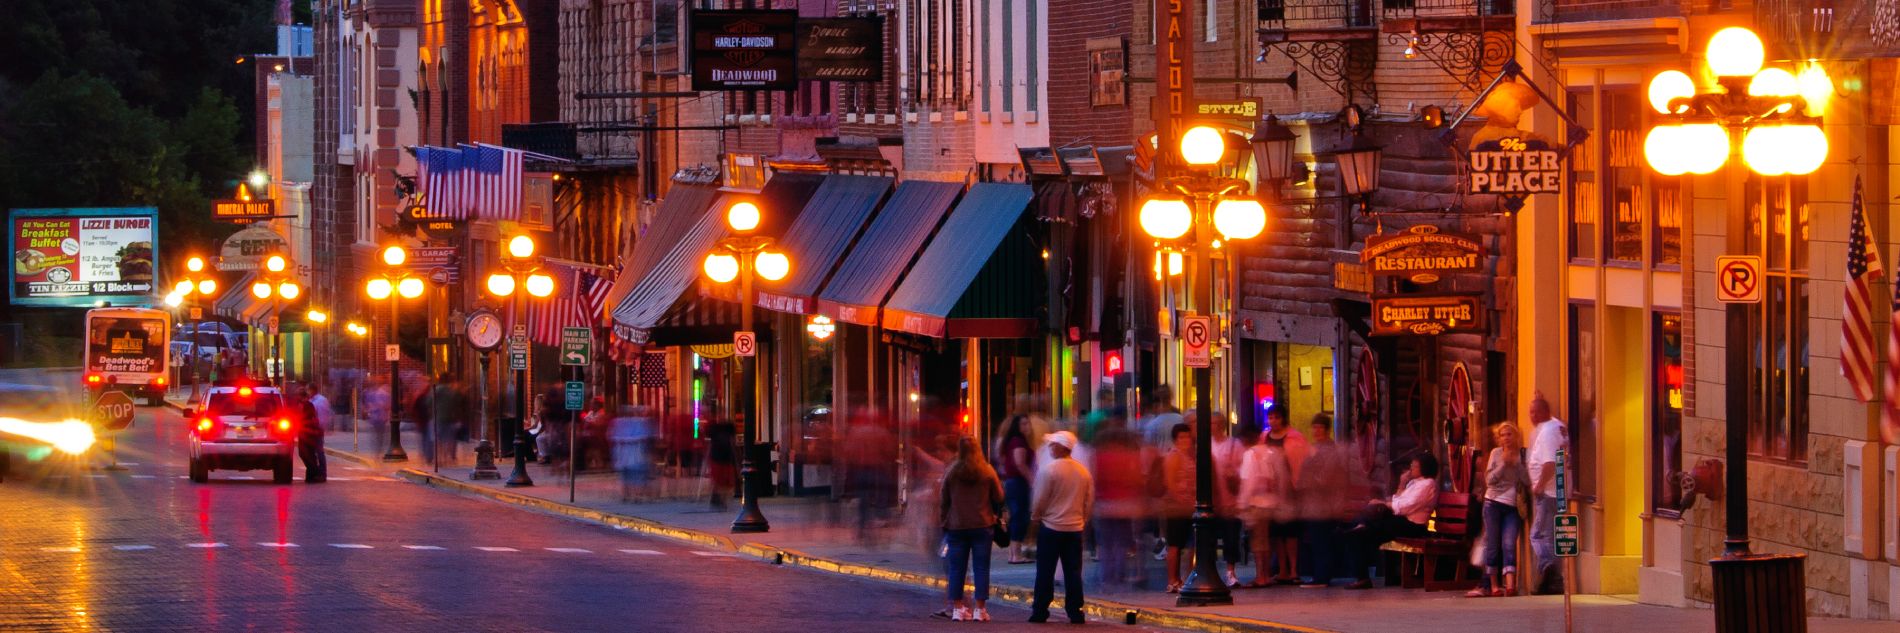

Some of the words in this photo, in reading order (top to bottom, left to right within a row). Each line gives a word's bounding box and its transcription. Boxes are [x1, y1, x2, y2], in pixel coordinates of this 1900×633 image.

[714, 36, 774, 48] HARLEY-DAVIDSON
[712, 69, 777, 81] DEADWOOD
[1168, 0, 1183, 140] SALOON
[1198, 101, 1257, 117] STYLE
[1471, 151, 1559, 172] UTTER
[1471, 171, 1559, 192] PLACE
[217, 203, 245, 215] MINERAL
[246, 202, 269, 215] PALACE
[82, 219, 111, 230] LIZZIE
[113, 218, 150, 230] BURGER
[429, 222, 454, 230] HOTEL
[21, 228, 69, 238] Breakfast
[30, 238, 61, 248] Buffet
[1371, 235, 1421, 256] DEADWOOD
[1423, 235, 1455, 244] SOCIAL
[1457, 239, 1479, 252] CLUB
[91, 262, 112, 270] Burger
[1375, 253, 1478, 271] RESTAURANT
[51, 284, 90, 292] LIZZIE
[107, 282, 132, 292] Block
[1382, 306, 1430, 323] CHARLEY
[1434, 304, 1471, 321] UTTER
[99, 356, 155, 365] Deadwood's
[106, 363, 127, 371] Best
[129, 363, 149, 372] Bet!
[99, 402, 132, 419] STOP
